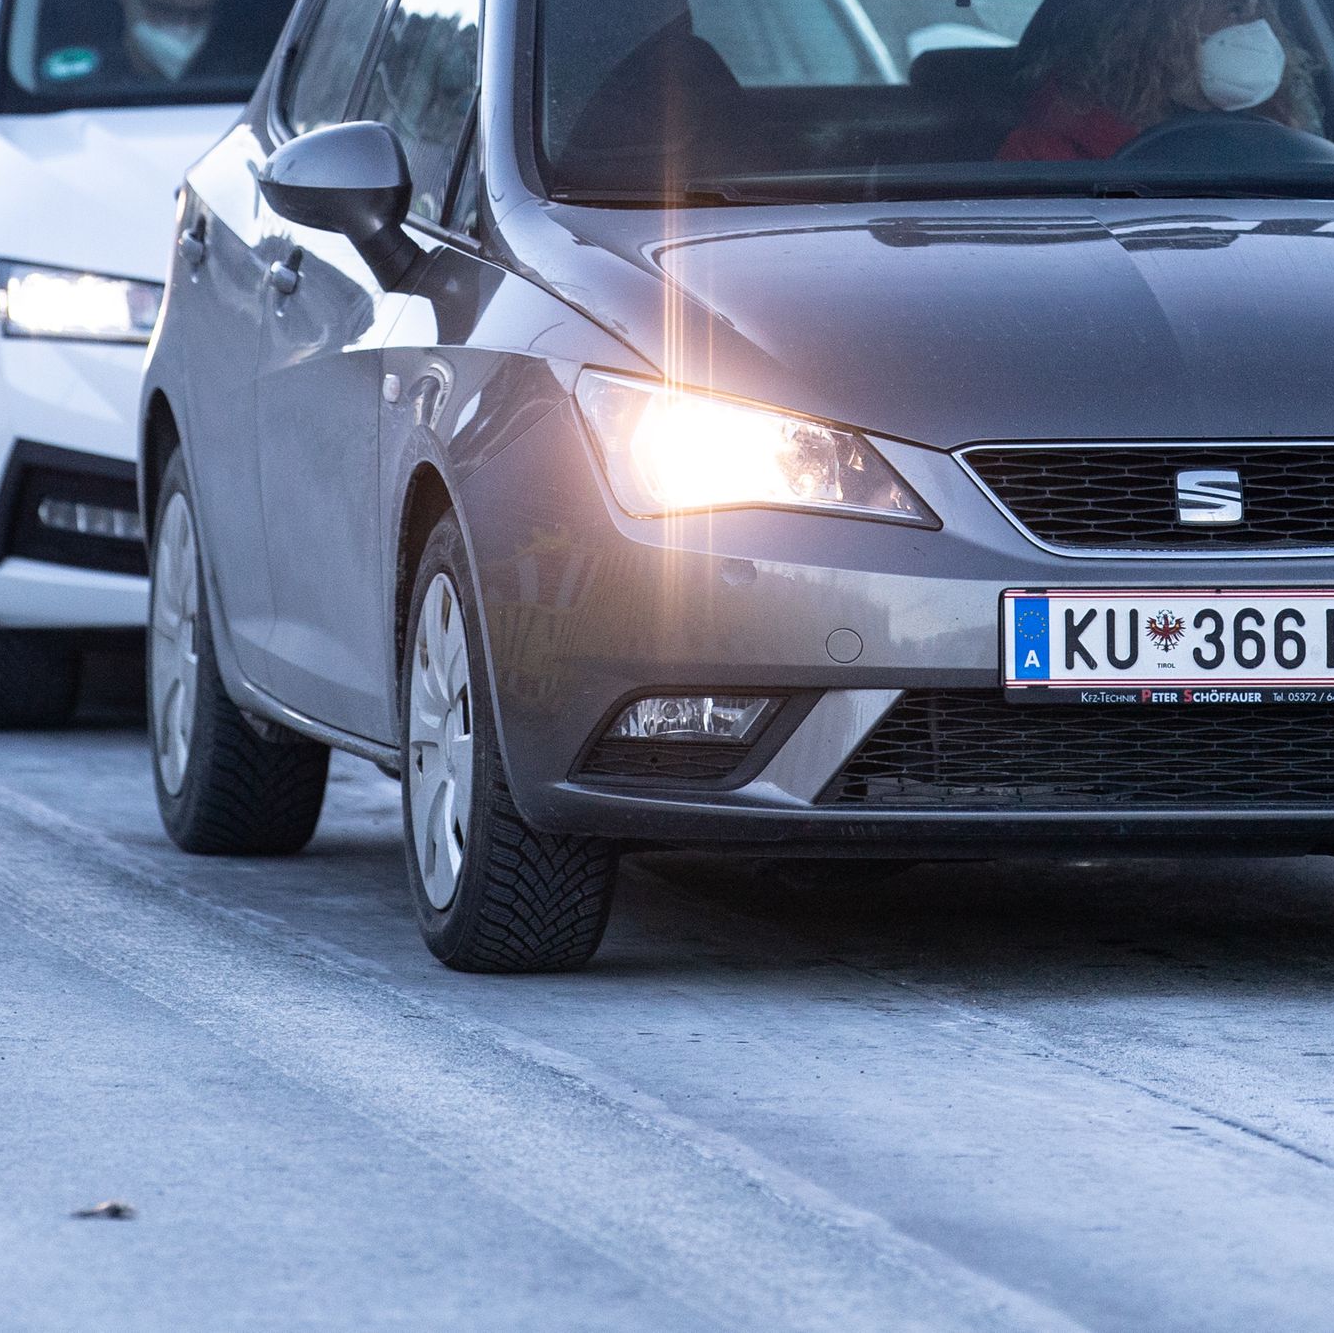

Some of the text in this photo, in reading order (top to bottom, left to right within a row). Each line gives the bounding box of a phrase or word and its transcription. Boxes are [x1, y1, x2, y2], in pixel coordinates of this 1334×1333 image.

[1064, 608, 1139, 670] KU
[1193, 607, 1306, 670] 366
[1024, 650, 1040, 668] A
[1141, 689, 1178, 703] PETER
[1183, 689, 1262, 703] SCHÖFFAUER
[1273, 692, 1286, 702] Tel.
[1288, 692, 1317, 702] 05372
